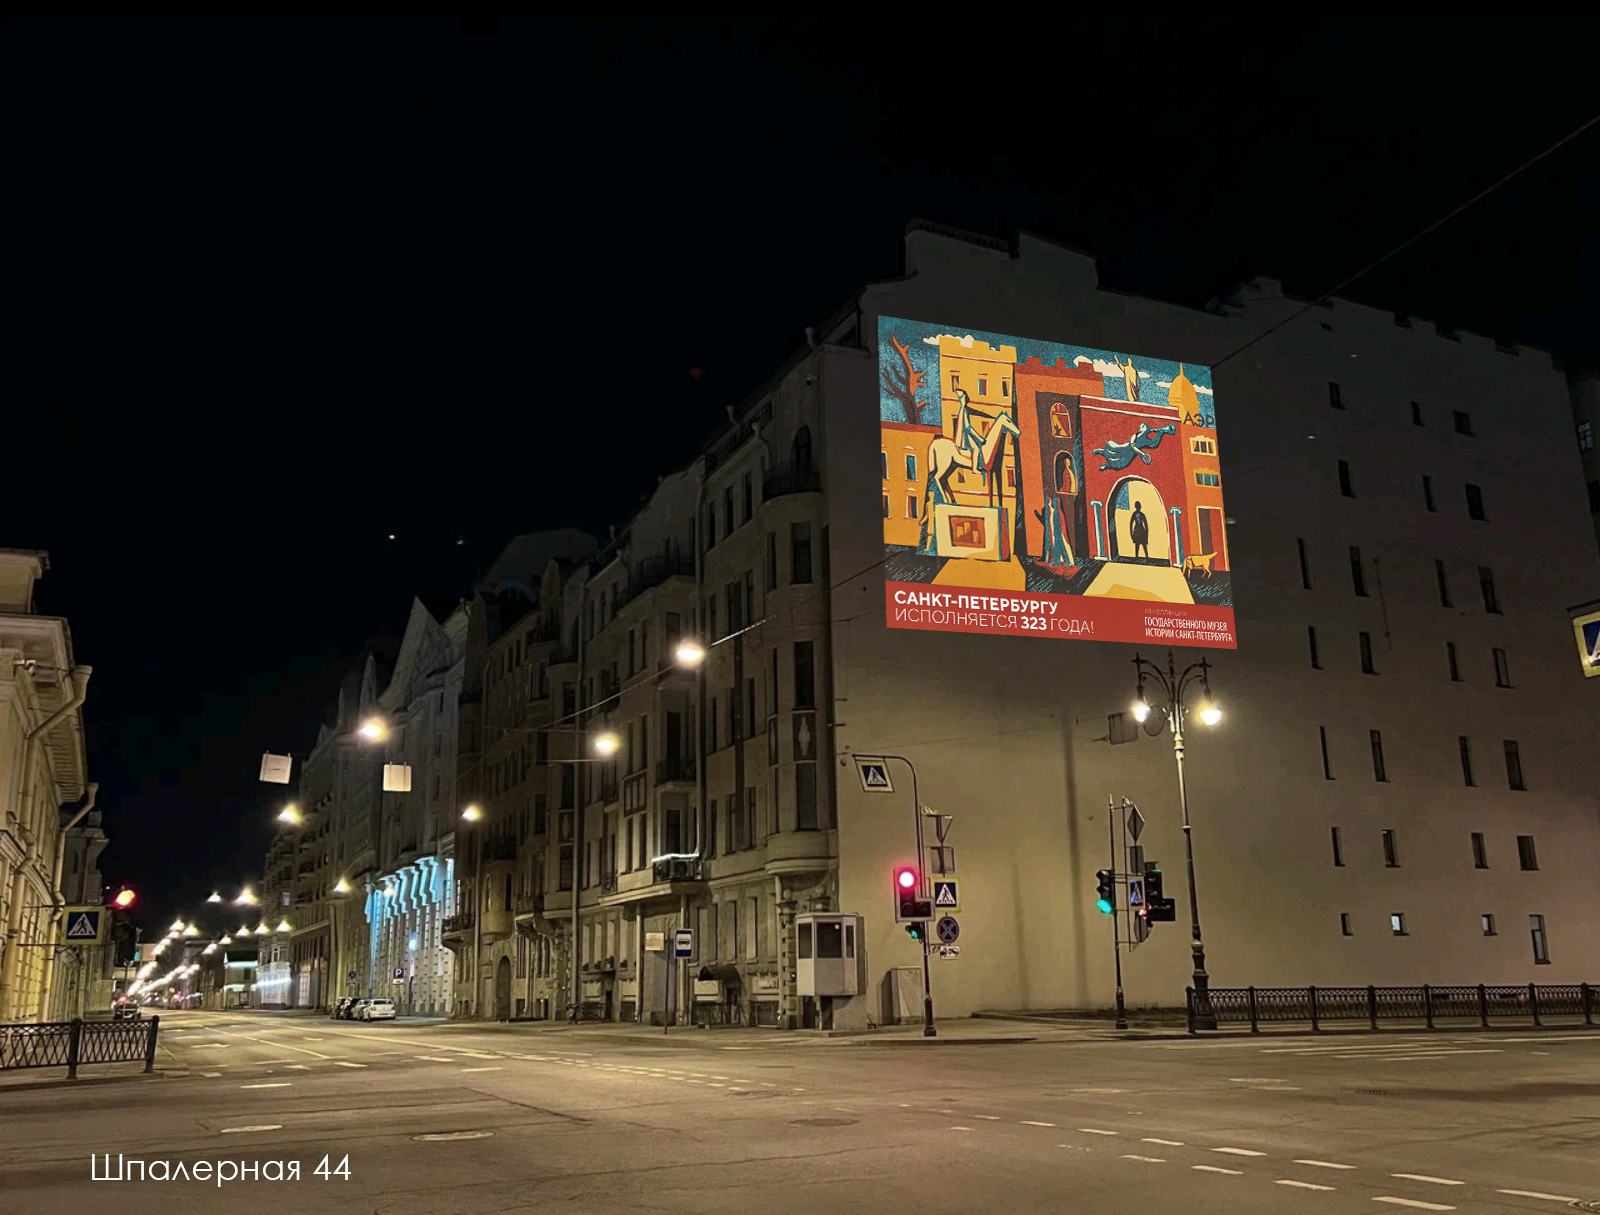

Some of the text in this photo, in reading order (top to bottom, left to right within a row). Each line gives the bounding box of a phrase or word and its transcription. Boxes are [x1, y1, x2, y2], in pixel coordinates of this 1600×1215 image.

[1183, 411, 1214, 428] АЭР
[894, 590, 1058, 615] САНКТ-ПЕТЕРБУРГУ
[895, 607, 1094, 635] ИСПОЛНЯЕТСЯ 323 ГОДА!
[1144, 616, 1228, 632] ГОСУДАРСТВЕННОГО МУЗЕЯ
[1145, 627, 1233, 642] ИСТОРИИ САНКТ-ПЕТЕРБУРГА
